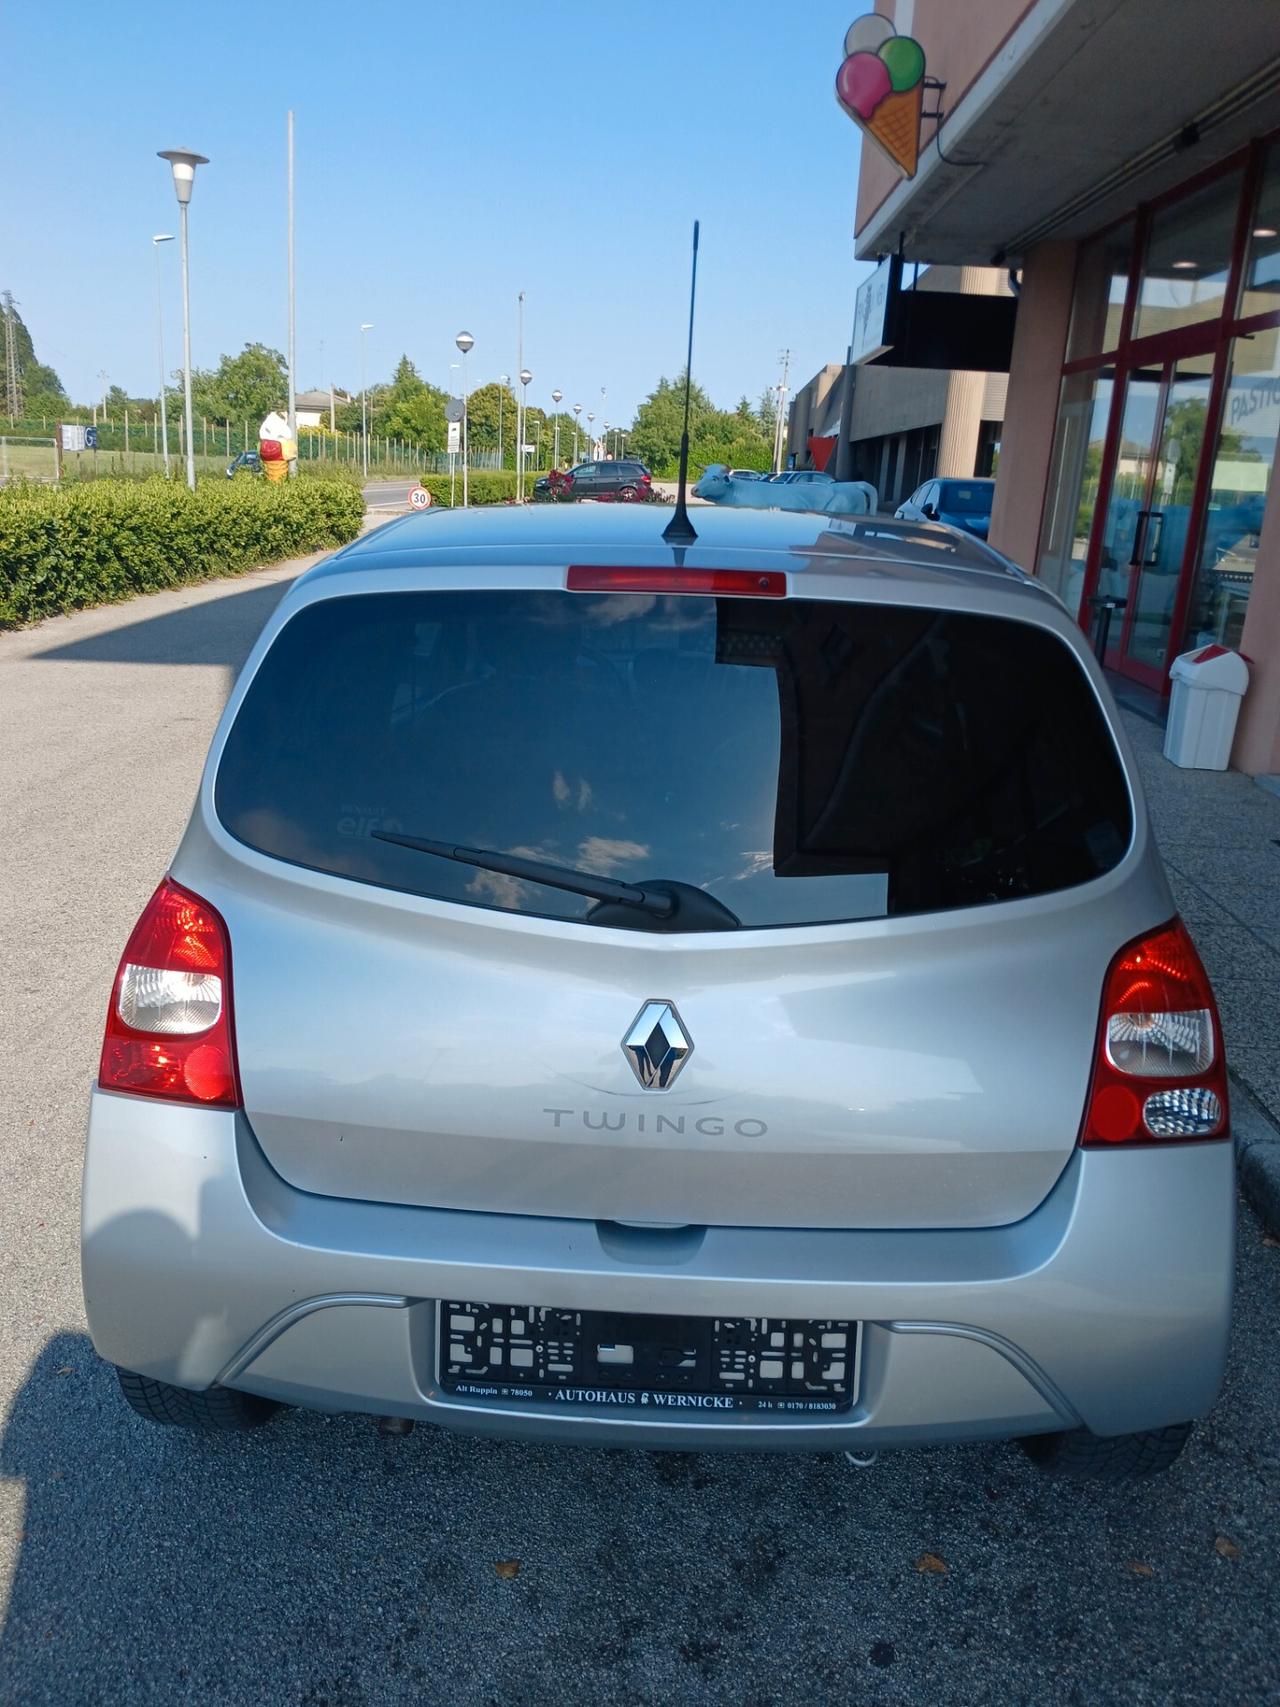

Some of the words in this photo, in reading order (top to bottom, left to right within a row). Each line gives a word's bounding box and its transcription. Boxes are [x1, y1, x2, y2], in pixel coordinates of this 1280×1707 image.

[413, 492, 426, 504] 30
[542, 1108, 769, 1138] TWINGO
[455, 1384, 468, 1393] Alt
[469, 1385, 498, 1396] Ruppin
[510, 1388, 533, 1397] 78050
[554, 1389, 636, 1404] AUTOHAUS
[653, 1393, 734, 1409] WERNICKE
[757, 1400, 767, 1409] 24
